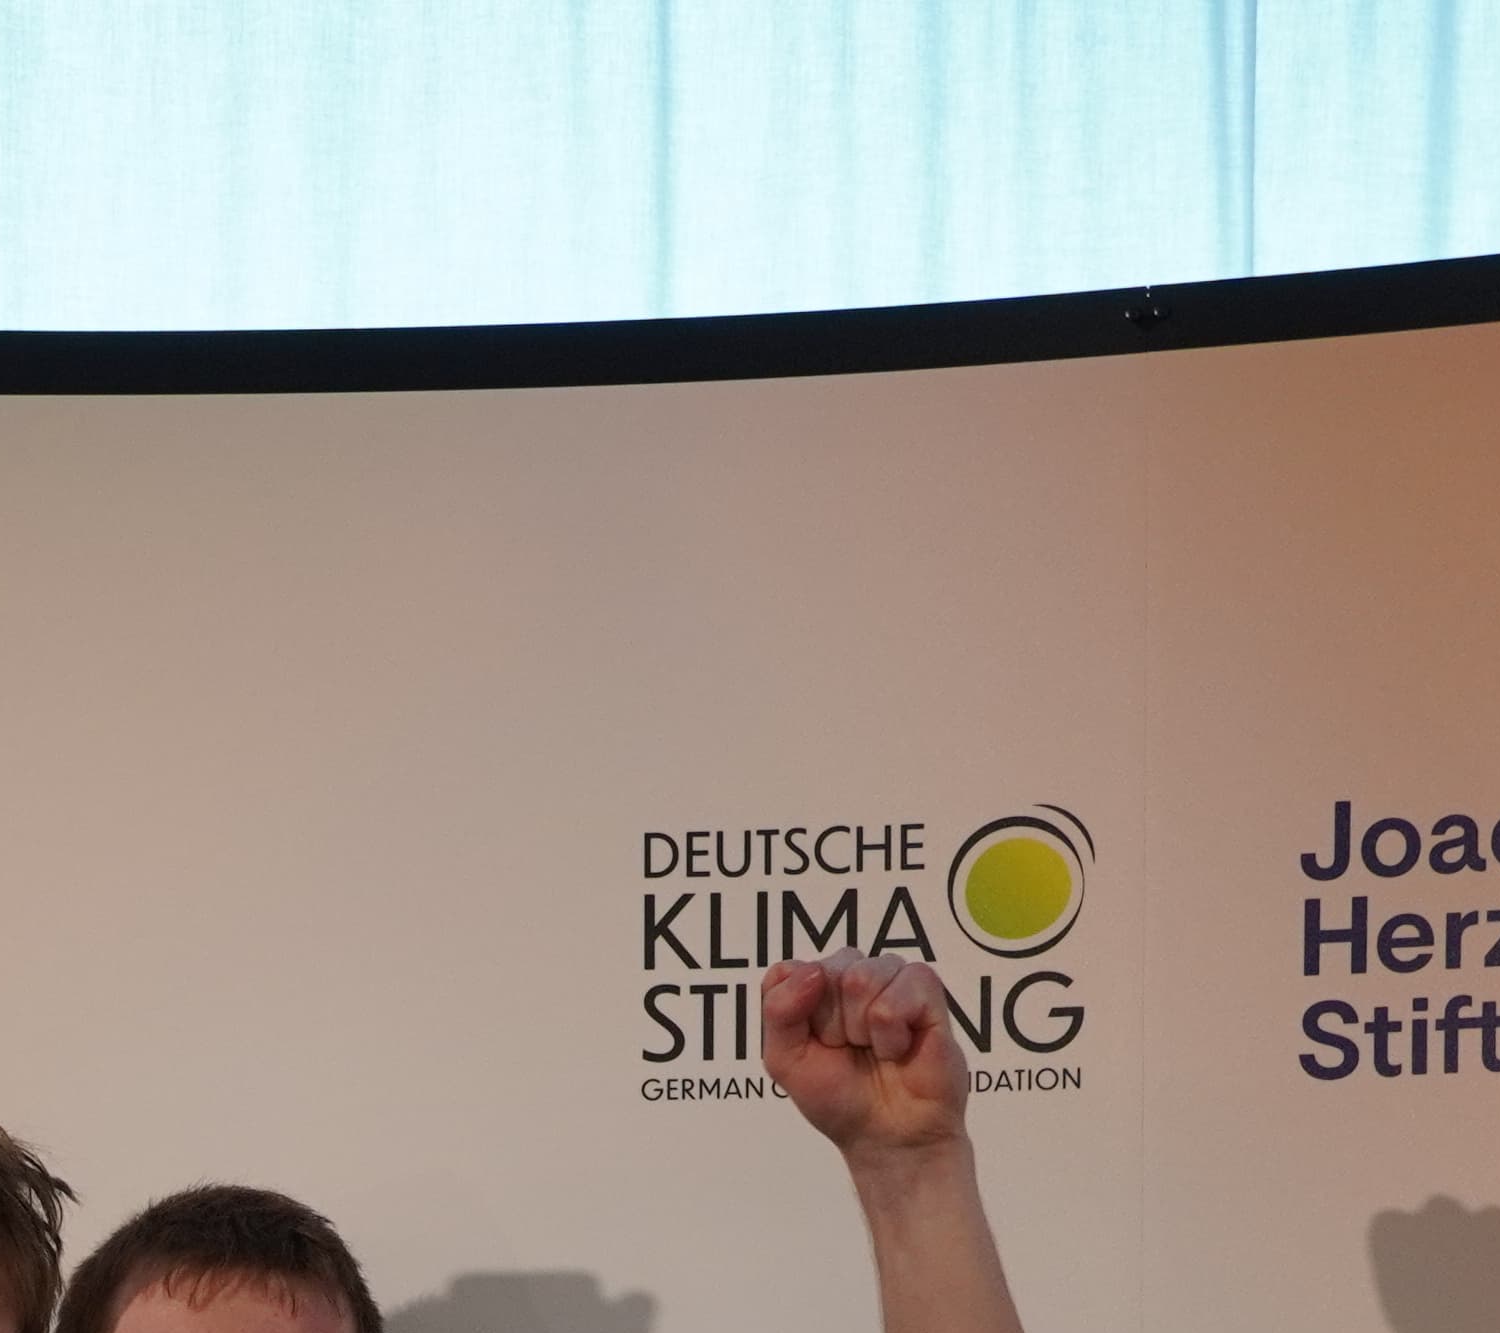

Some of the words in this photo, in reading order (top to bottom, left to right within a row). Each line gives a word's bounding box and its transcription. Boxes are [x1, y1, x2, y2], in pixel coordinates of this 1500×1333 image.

[643, 822, 925, 879] DEUTSCHE
[643, 886, 937, 970] KLIMA
[642, 971, 1085, 1063] STING
[641, 1077, 764, 1102] GERMAN
